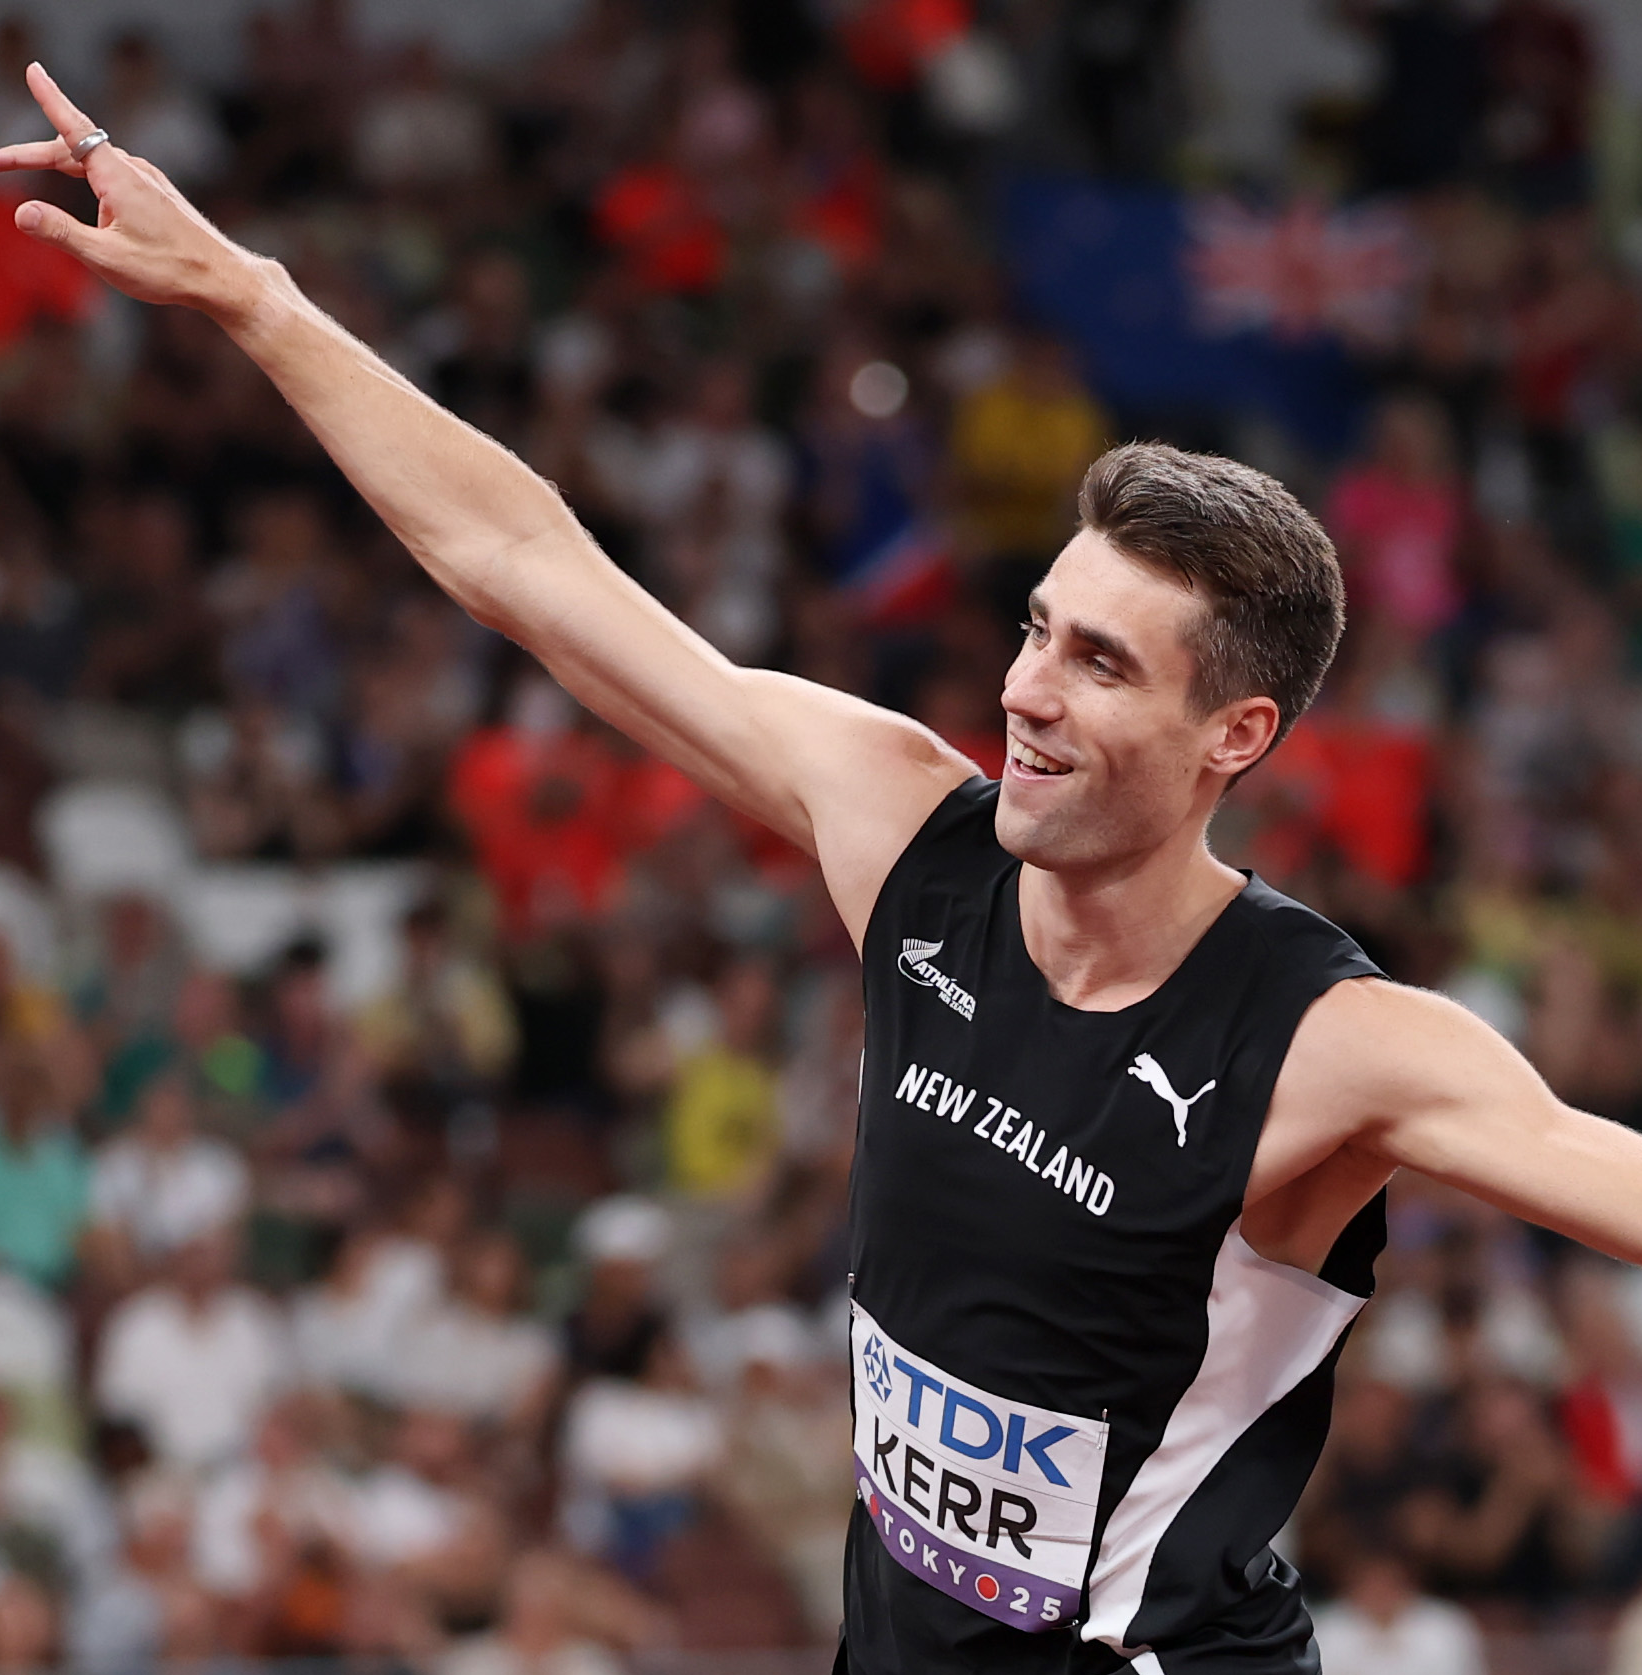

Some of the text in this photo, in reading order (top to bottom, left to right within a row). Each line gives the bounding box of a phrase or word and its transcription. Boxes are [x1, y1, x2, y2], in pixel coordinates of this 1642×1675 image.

[895, 1063, 1115, 1216] NEW ZEALAND
[874, 1414, 1038, 1560] KERR
[893, 1354, 1080, 1489] TDK
